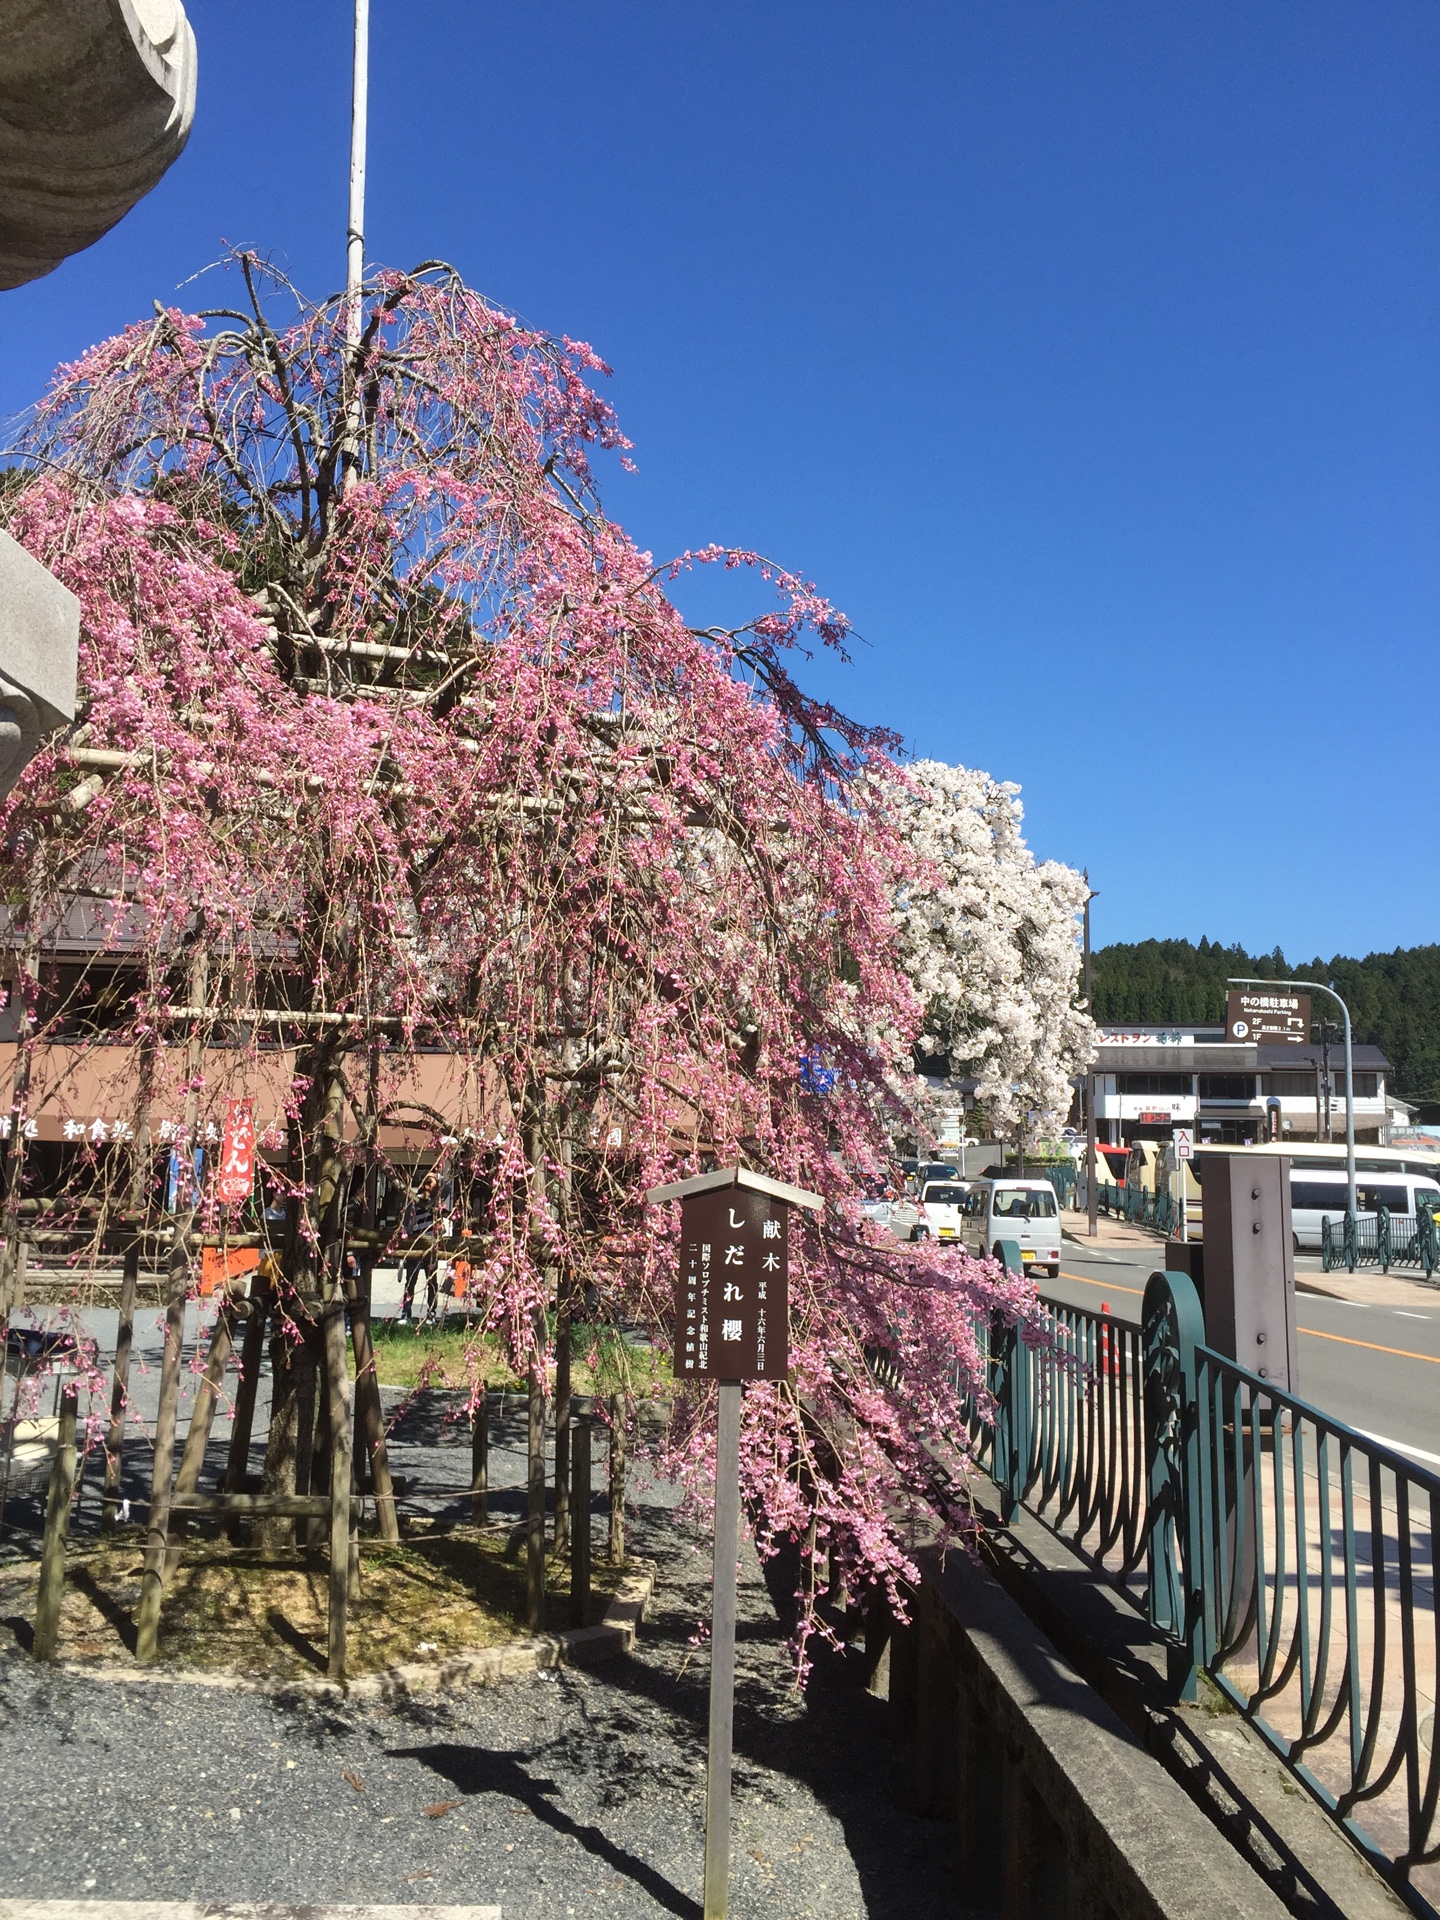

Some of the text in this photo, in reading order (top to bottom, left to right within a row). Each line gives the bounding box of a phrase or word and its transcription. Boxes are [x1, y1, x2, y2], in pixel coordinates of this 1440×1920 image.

[1241, 996, 1298, 1009] 中の橋駐車場
[1099, 1032, 1151, 1044] レストラン
[1237, 1025, 1245, 1035] P
[1178, 1130, 1190, 1157] 入口
[721, 1208, 746, 1342] しだれ櫻
[685, 1243, 698, 1369] 二十周年記念植樹
[757, 1220, 781, 1371] 献木 平成 十六年六月三日
